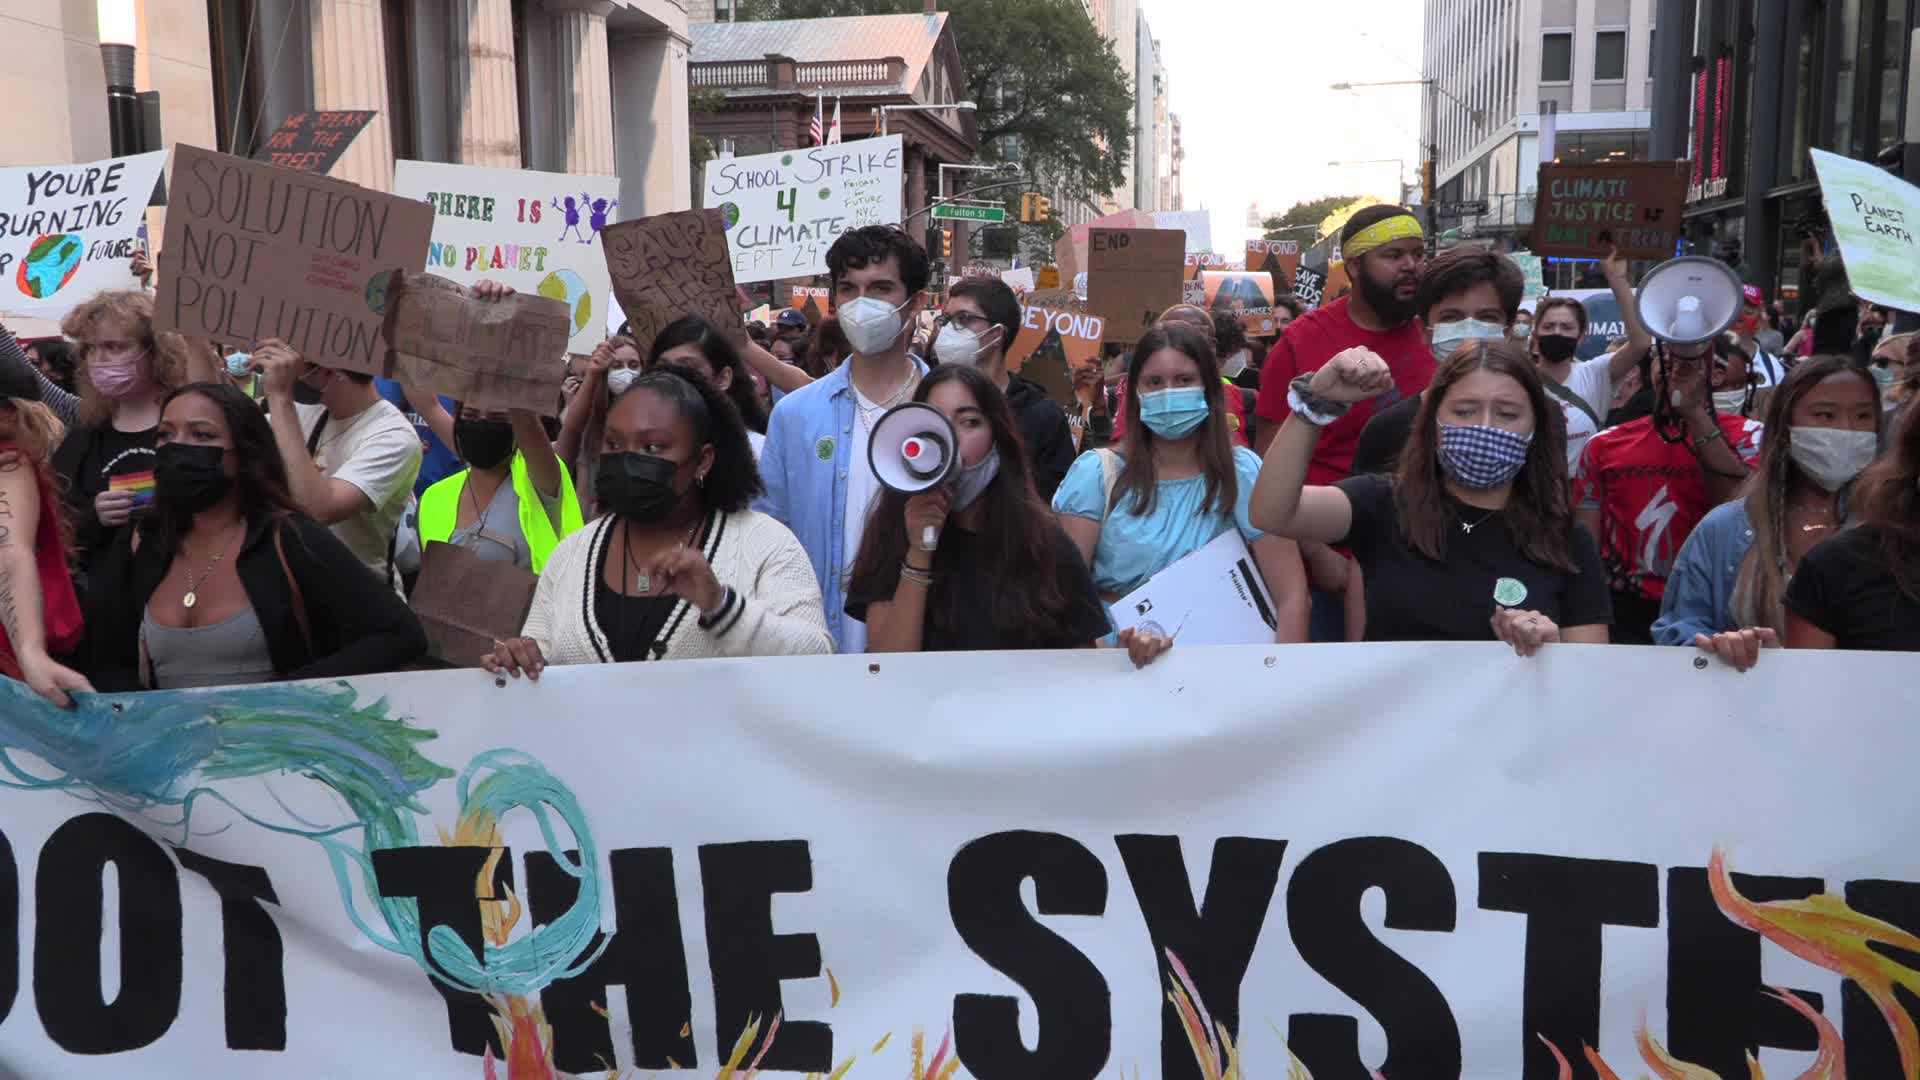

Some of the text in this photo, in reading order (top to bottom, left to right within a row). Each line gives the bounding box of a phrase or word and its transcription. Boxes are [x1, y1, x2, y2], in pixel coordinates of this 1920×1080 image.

[712, 148, 900, 196] SCHOOL STRIKE
[186, 157, 389, 260] SOLUTION
[426, 191, 541, 224] THERE IS
[776, 188, 797, 223] 4
[950, 208, 975, 217] Fulton
[1850, 193, 1904, 223] PLANET
[736, 217, 844, 249] CLIMATE
[1093, 232, 1129, 251] END
[1864, 216, 1912, 245] EARTH
[86, 238, 134, 262] FUTURE
[181, 224, 267, 285] NOT
[428, 242, 547, 272] NO PLANET
[735, 249, 782, 272] EPT
[1184, 253, 1226, 267] EYOND
[1247, 241, 1298, 255] BEYOND
[961, 266, 1001, 277] BEYOND
[792, 287, 830, 297] BEYOND
[175, 275, 380, 364] POLLUTION
[1024, 305, 1102, 340] EYOND
[371, 839, 835, 1074] THE
